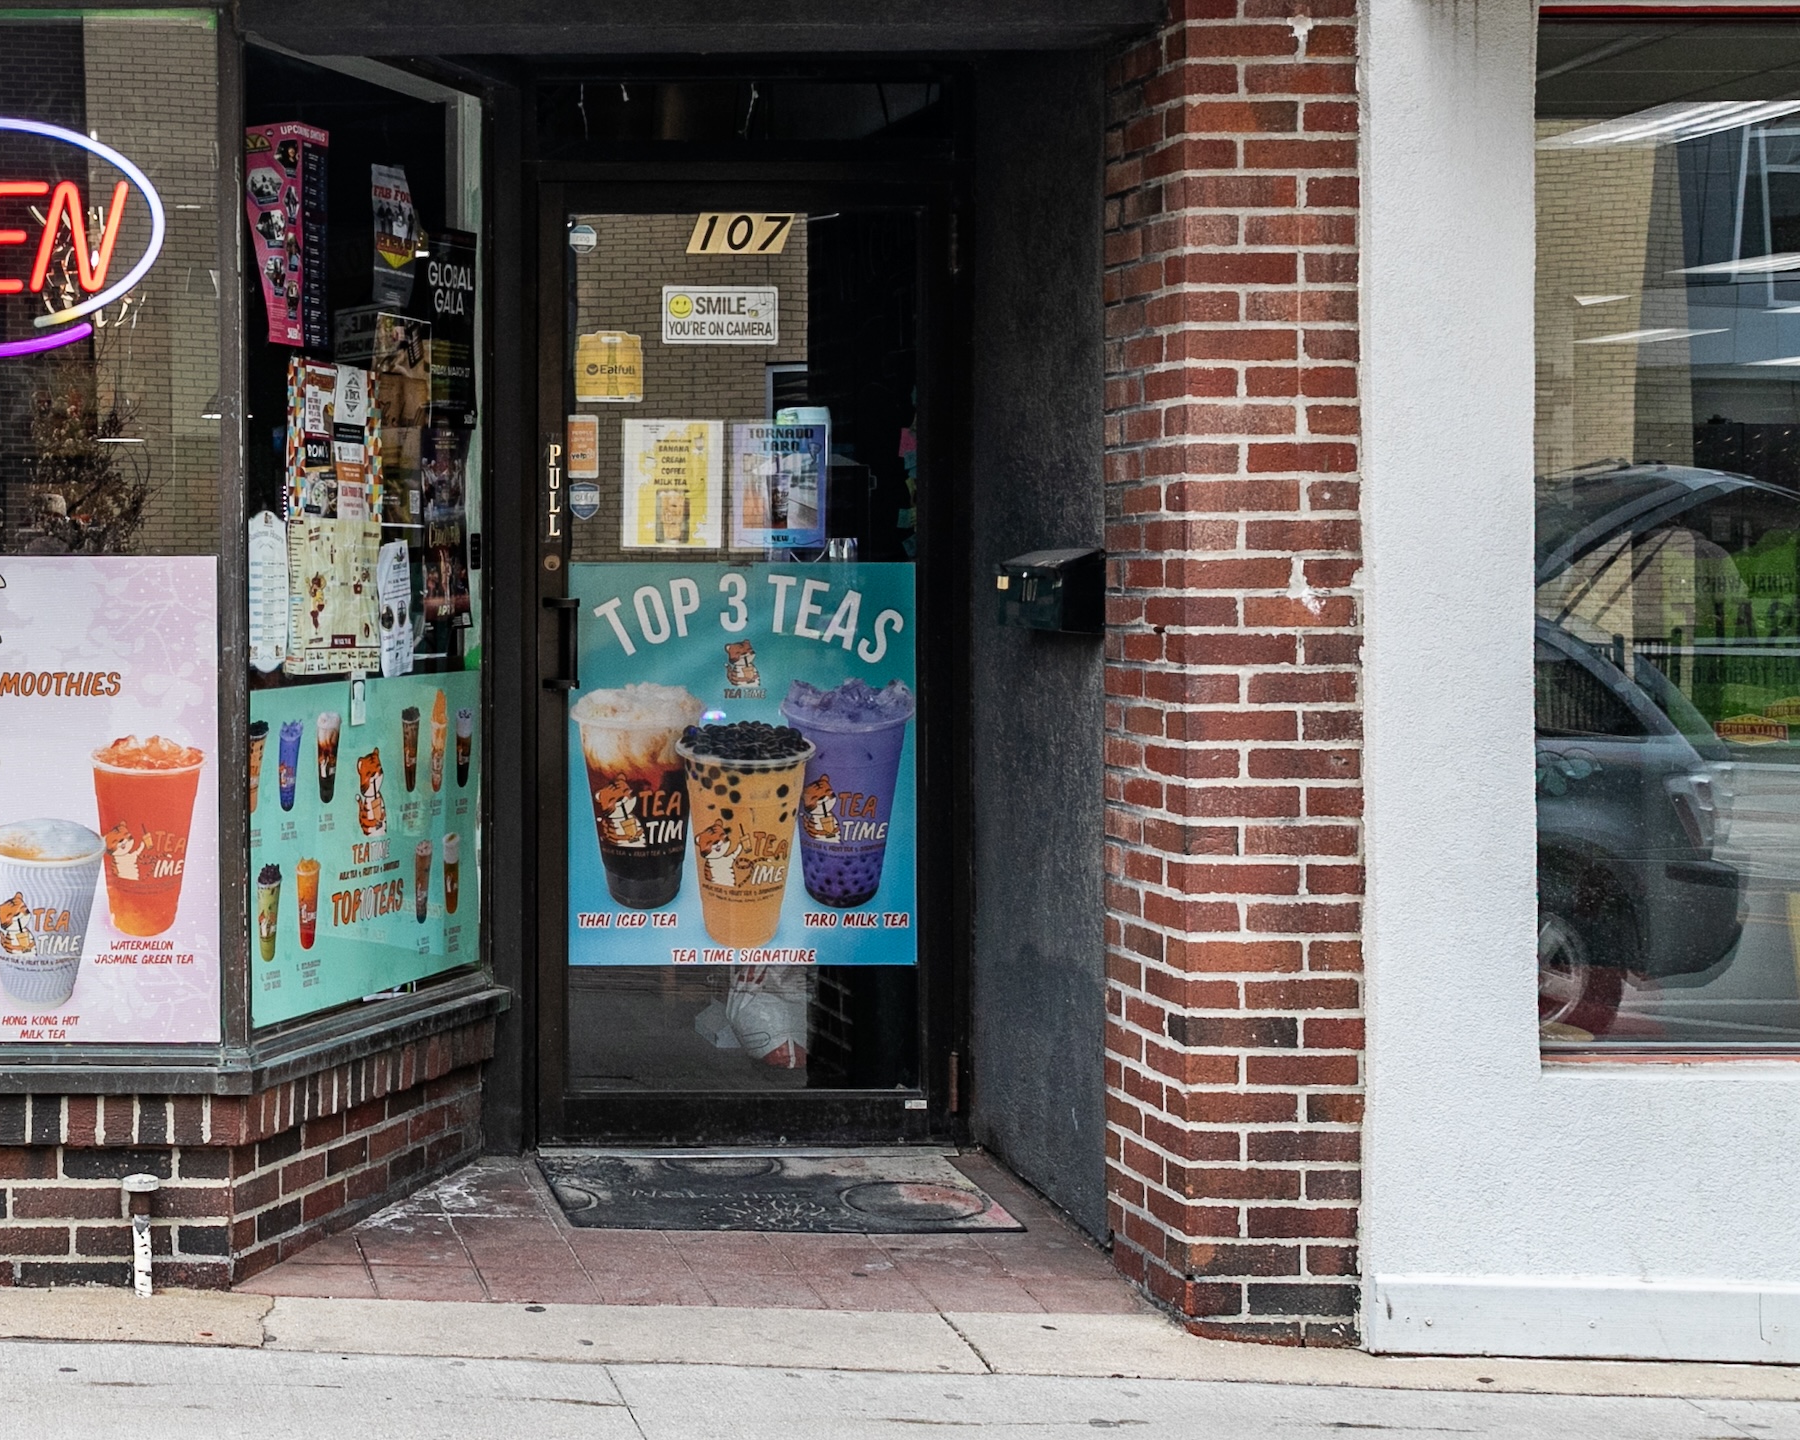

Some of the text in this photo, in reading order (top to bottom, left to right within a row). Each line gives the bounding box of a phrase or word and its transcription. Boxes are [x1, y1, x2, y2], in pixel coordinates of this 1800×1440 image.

[374, 185, 392, 199] FAB
[700, 215, 792, 251] 107
[428, 261, 473, 291] GLOBAL
[434, 289, 464, 315] GALA
[695, 297, 746, 315] SMILE
[668, 322, 773, 337] YOU'RE ON CAMERA
[748, 428, 814, 439] TORNADO
[761, 441, 800, 452] TARO
[548, 444, 561, 536] PULL
[593, 573, 904, 664] TOP 3 TEAS
[724, 689, 766, 699] TEA TIME
[639, 790, 681, 817] TEA
[838, 792, 878, 818] TEA
[843, 821, 888, 841] TIME
[155, 831, 186, 854] TEA
[753, 831, 788, 860] TEA
[352, 842, 370, 864] TEA
[332, 888, 362, 926] TOP
[374, 878, 404, 917] TEAS
[33, 908, 70, 932] TEA
[578, 913, 677, 928] THAI ICED TEA
[804, 913, 908, 928] TARO MILK TEA
[38, 935, 81, 955] TIME
[110, 940, 173, 951] WATERMELON
[94, 954, 194, 964] JASMINE GREEN TEA
[672, 949, 816, 963] TEA TIME SIGNATURE
[2, 1015, 80, 1026] HONG KONG HOT
[20, 1029, 65, 1040] MILK TEA
